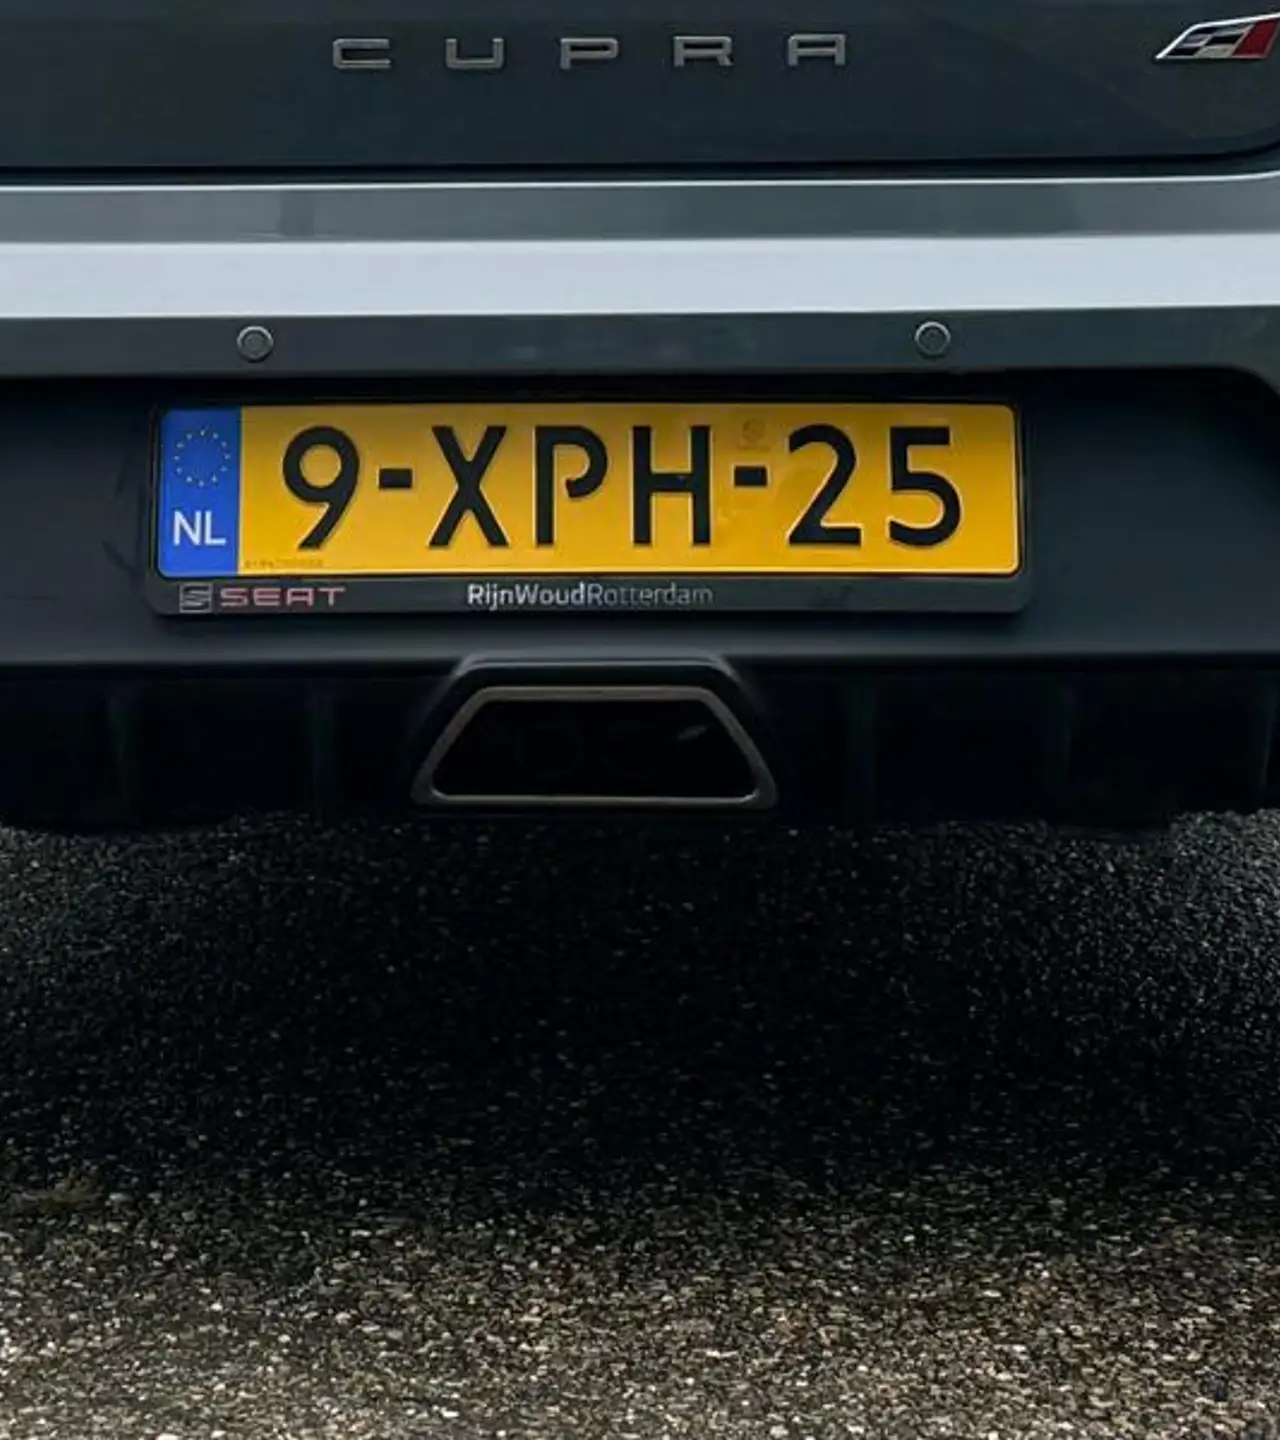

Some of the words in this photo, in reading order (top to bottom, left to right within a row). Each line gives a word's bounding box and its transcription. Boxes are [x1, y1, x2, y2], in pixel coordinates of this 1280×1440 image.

[333, 33, 847, 70] CUPRA
[281, 424, 963, 549] 9-XPH-25
[172, 511, 227, 547] NL
[220, 586, 347, 607] SEAT
